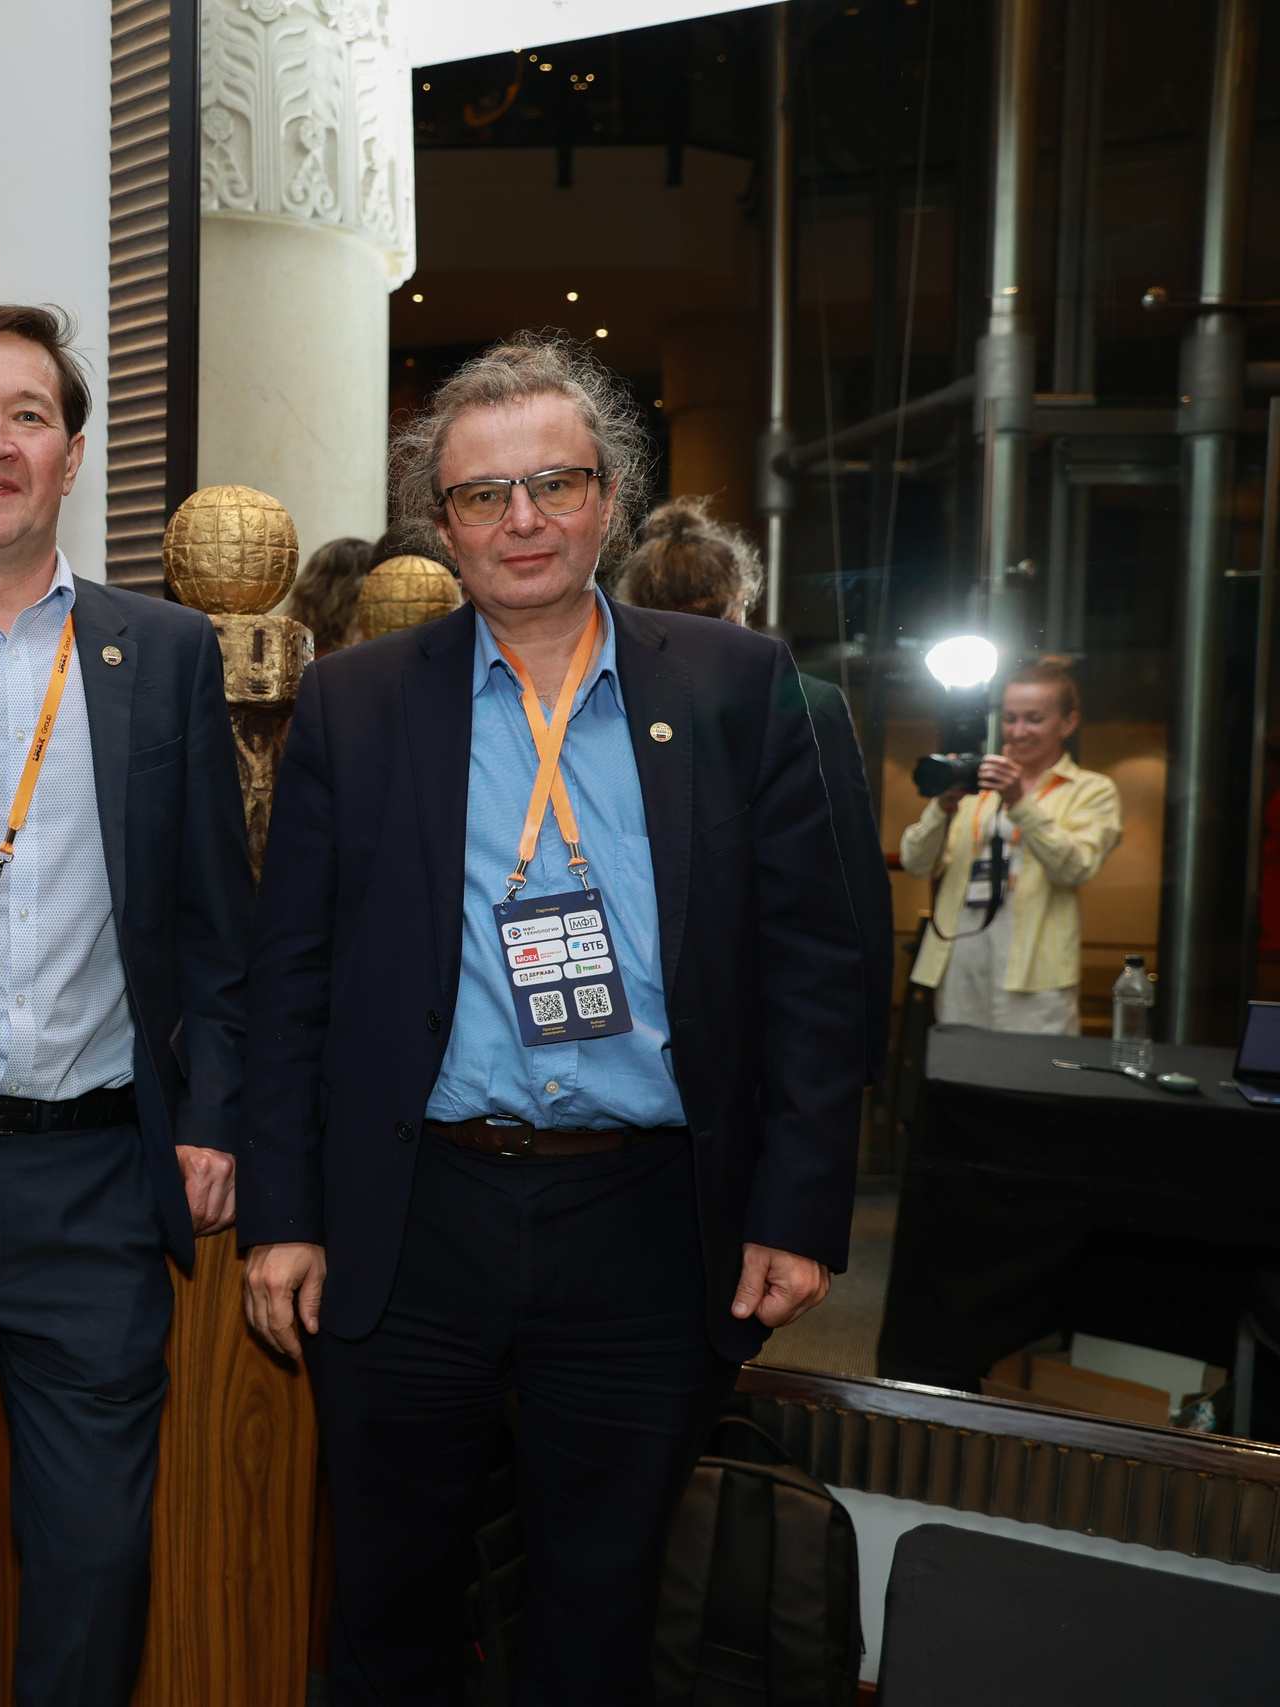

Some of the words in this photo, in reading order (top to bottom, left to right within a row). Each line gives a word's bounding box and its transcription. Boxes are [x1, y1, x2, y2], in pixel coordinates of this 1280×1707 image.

[57, 653, 68, 674] LMAX
[63, 634, 72, 651] Group
[32, 737, 46, 762] LMAX
[41, 714, 52, 735] Group
[523, 926, 560, 936] ТЕХНОЛОГИИ
[582, 940, 604, 952] ВТБ
[516, 954, 538, 963] MOEX
[529, 969, 555, 978] ДЕРЖАВА
